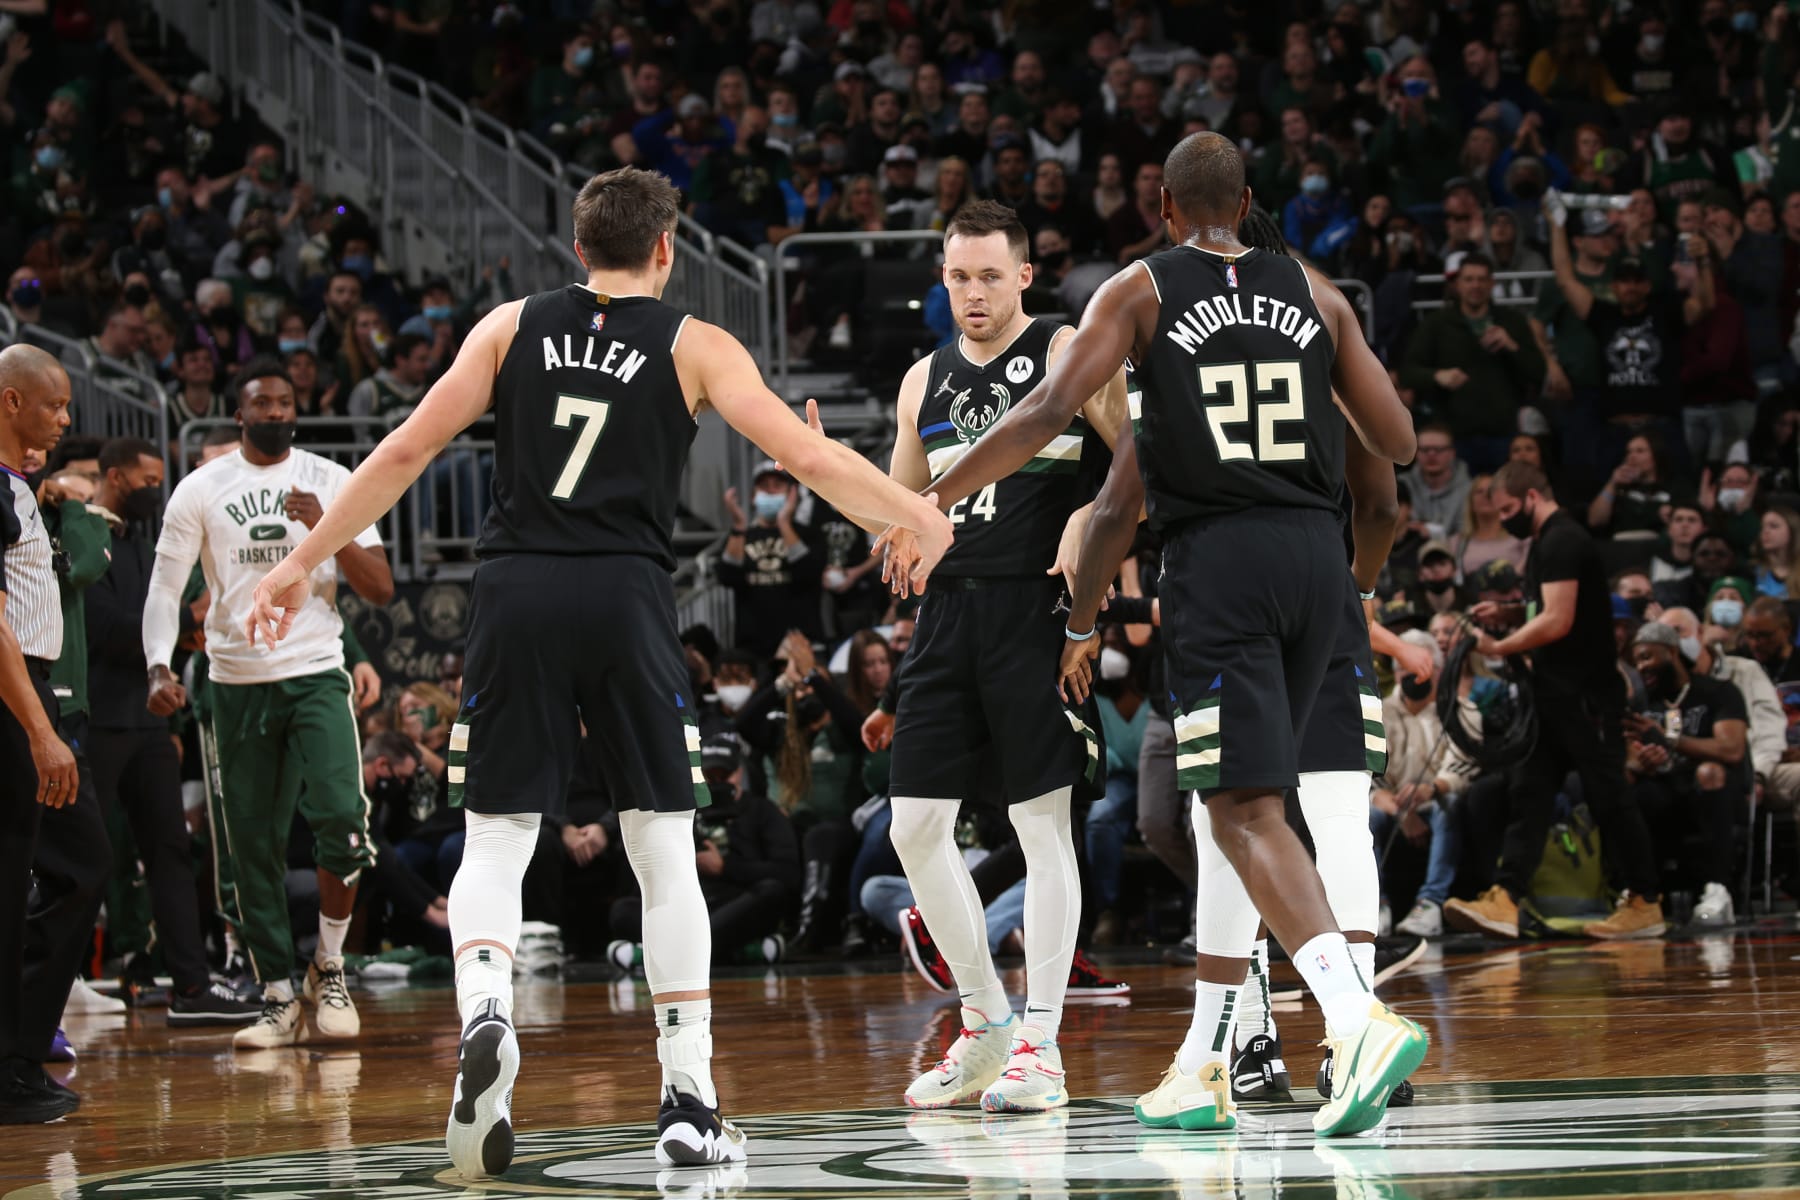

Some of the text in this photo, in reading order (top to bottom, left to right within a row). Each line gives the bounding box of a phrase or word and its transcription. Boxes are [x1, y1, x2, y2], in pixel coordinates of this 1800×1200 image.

[1166, 293, 1322, 356] MIDDLETON
[542, 333, 648, 384] ALLEN
[1196, 359, 1308, 464] 22
[550, 392, 613, 502] 7
[224, 487, 285, 527] BUCK
[238, 545, 295, 564] BASKETB
[1253, 1039, 1269, 1053] GT
